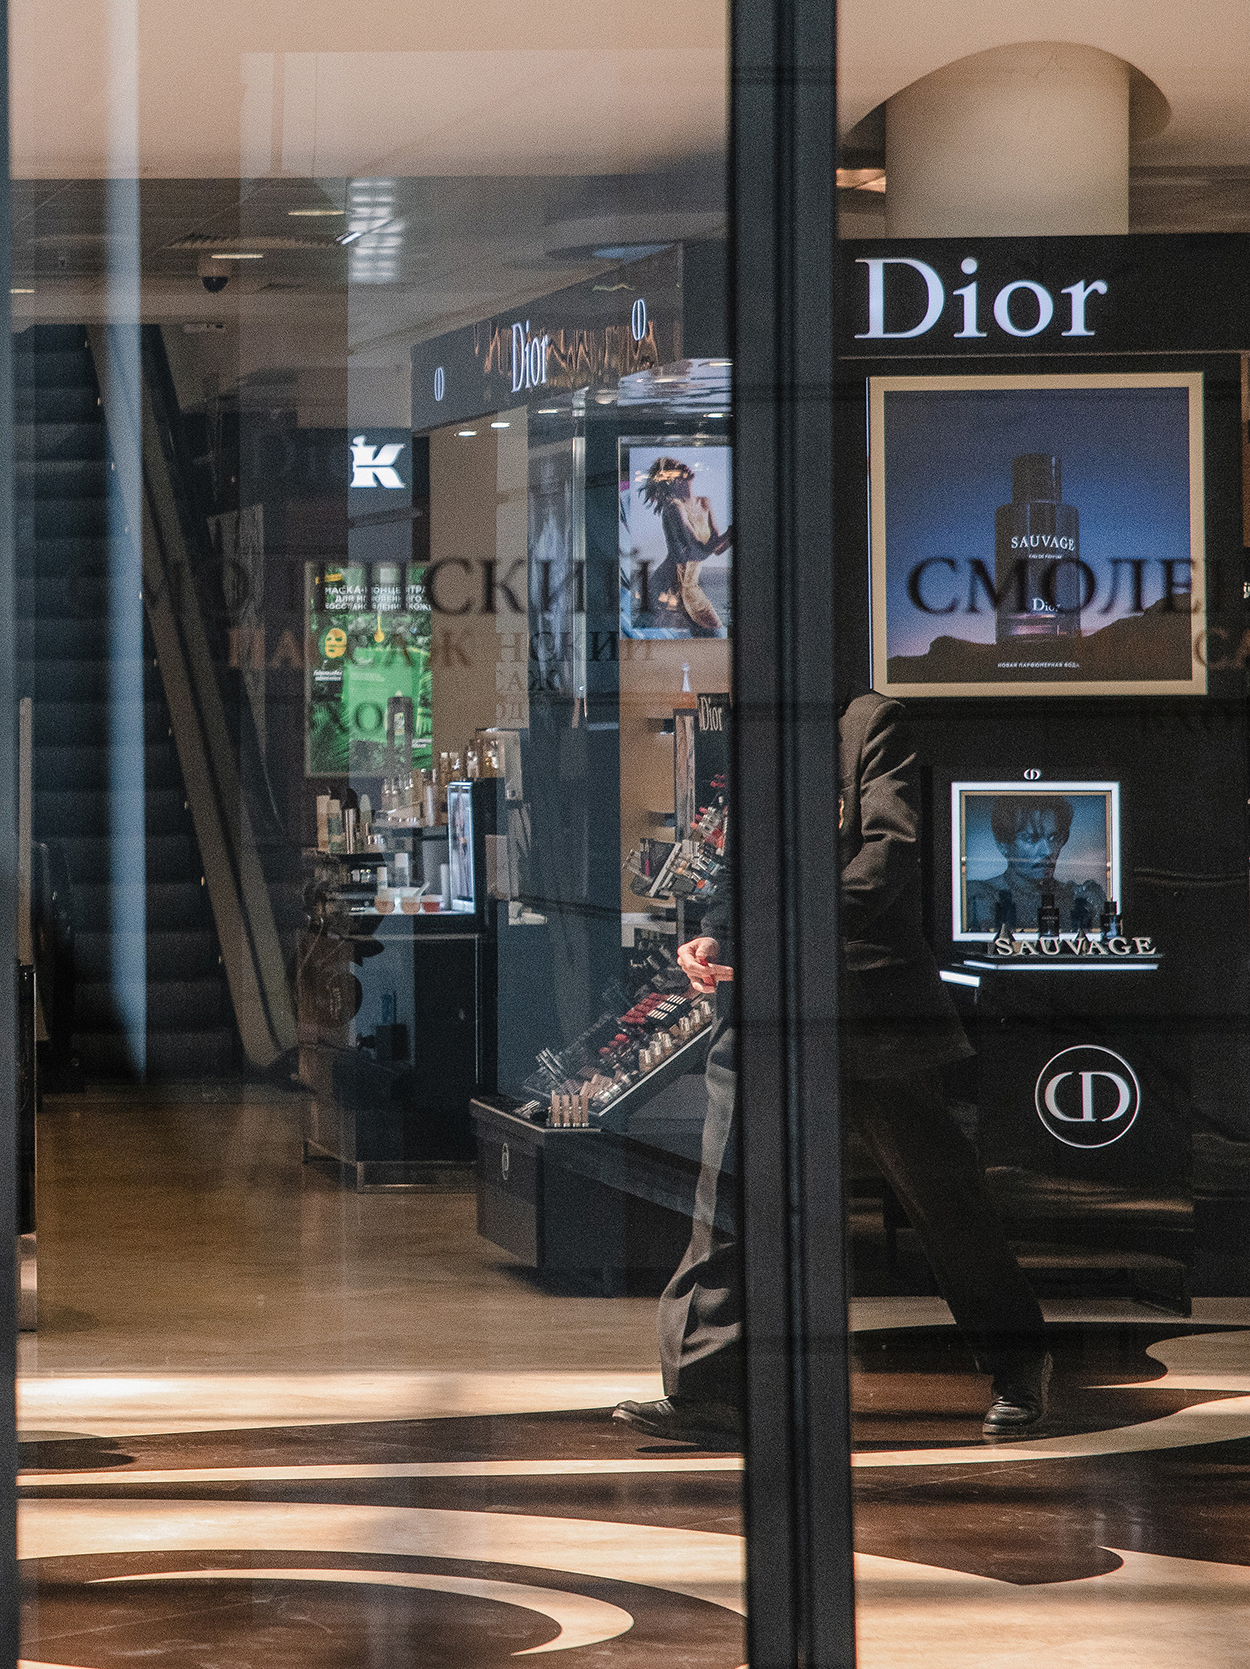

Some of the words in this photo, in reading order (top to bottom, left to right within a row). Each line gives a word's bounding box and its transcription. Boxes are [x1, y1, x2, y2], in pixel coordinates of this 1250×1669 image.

[854, 257, 1109, 339] Dior
[511, 320, 548, 393] Dior
[1010, 533, 1076, 552] SAUVAGE
[699, 696, 724, 731] Dior
[995, 936, 1157, 956] SAUVAGE
